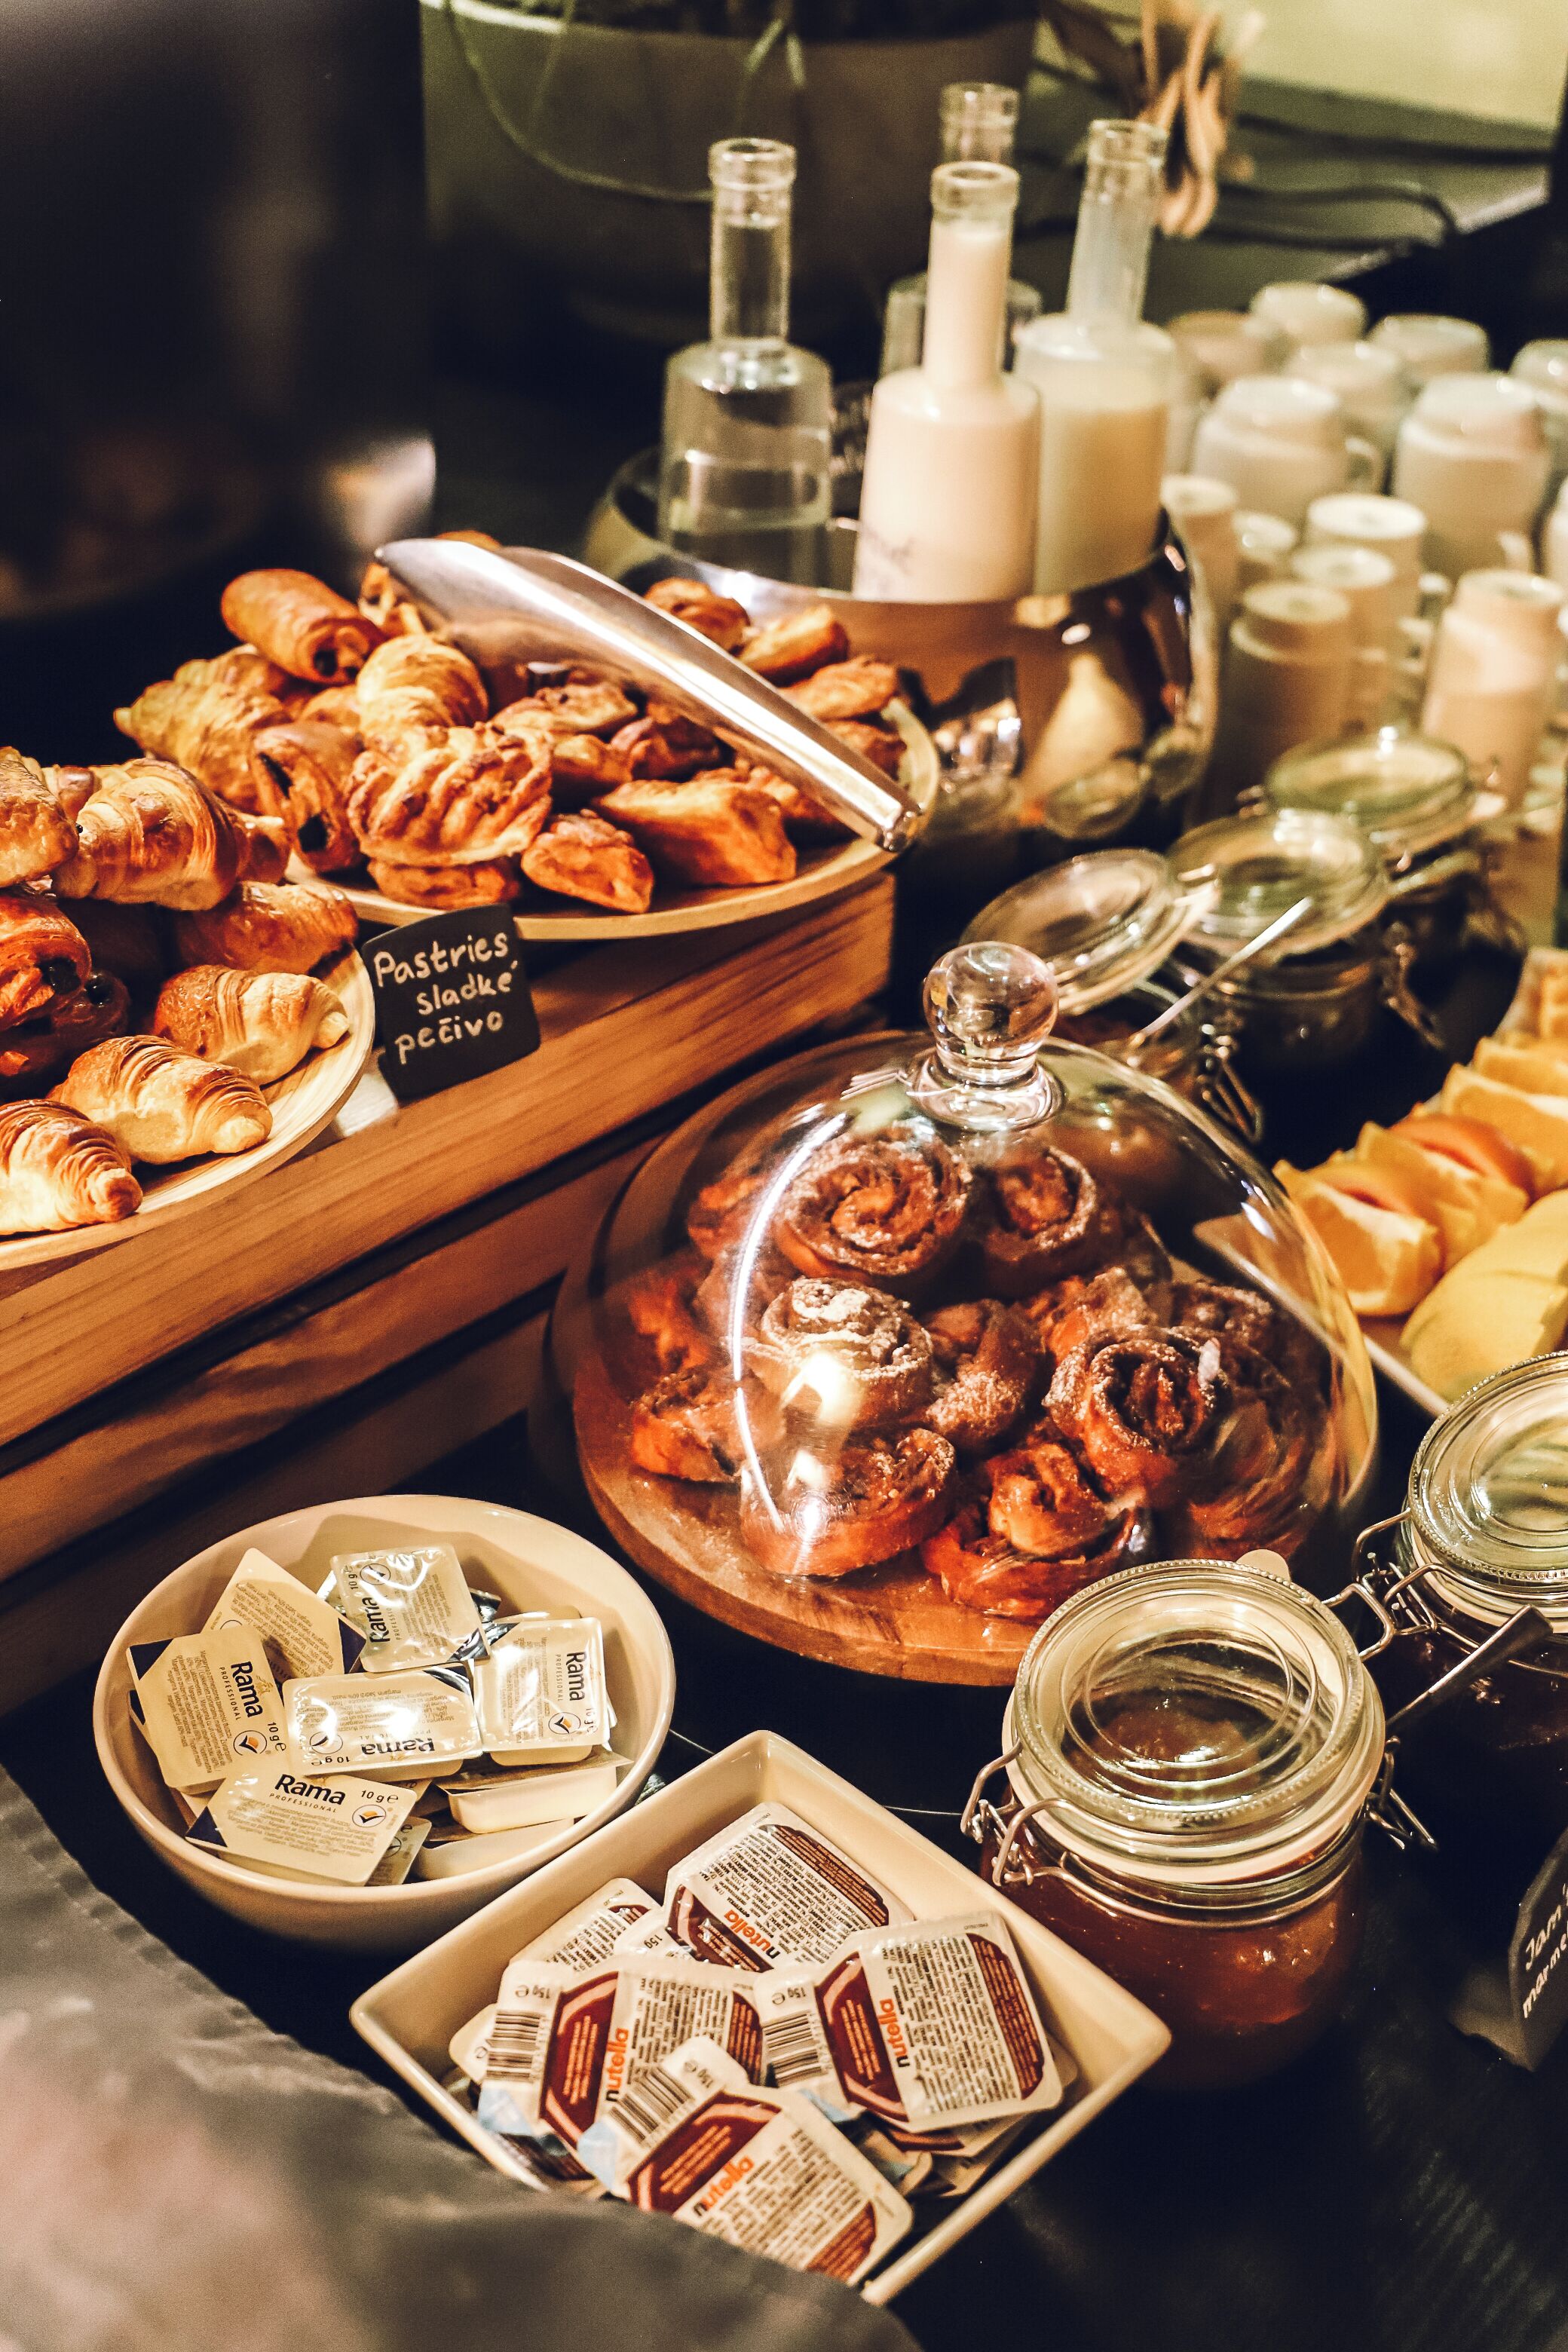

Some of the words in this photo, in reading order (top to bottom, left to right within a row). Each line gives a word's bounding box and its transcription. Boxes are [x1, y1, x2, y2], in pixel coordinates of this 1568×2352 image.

[372, 932, 509, 988] Pastries
[416, 960, 518, 1015] sladké
[394, 1011, 504, 1064] pečivo
[362, 1597, 390, 1643] Rama
[219, 1667, 241, 1720] PROFESSIONAL
[231, 1661, 263, 1717] Rama
[555, 1654, 563, 1701] PROFESSIONAL
[565, 1651, 587, 1701] Rama
[362, 1738, 435, 1755] Rama
[269, 1793, 337, 1813] PROFESSIONAL
[274, 1774, 346, 1805] Rama
[724, 1909, 781, 1959] nutella
[1525, 1904, 1561, 1972] Jam
[878, 1998, 910, 2068] nutella
[606, 2027, 629, 2102] nutella
[694, 2154, 755, 2216] nutella
